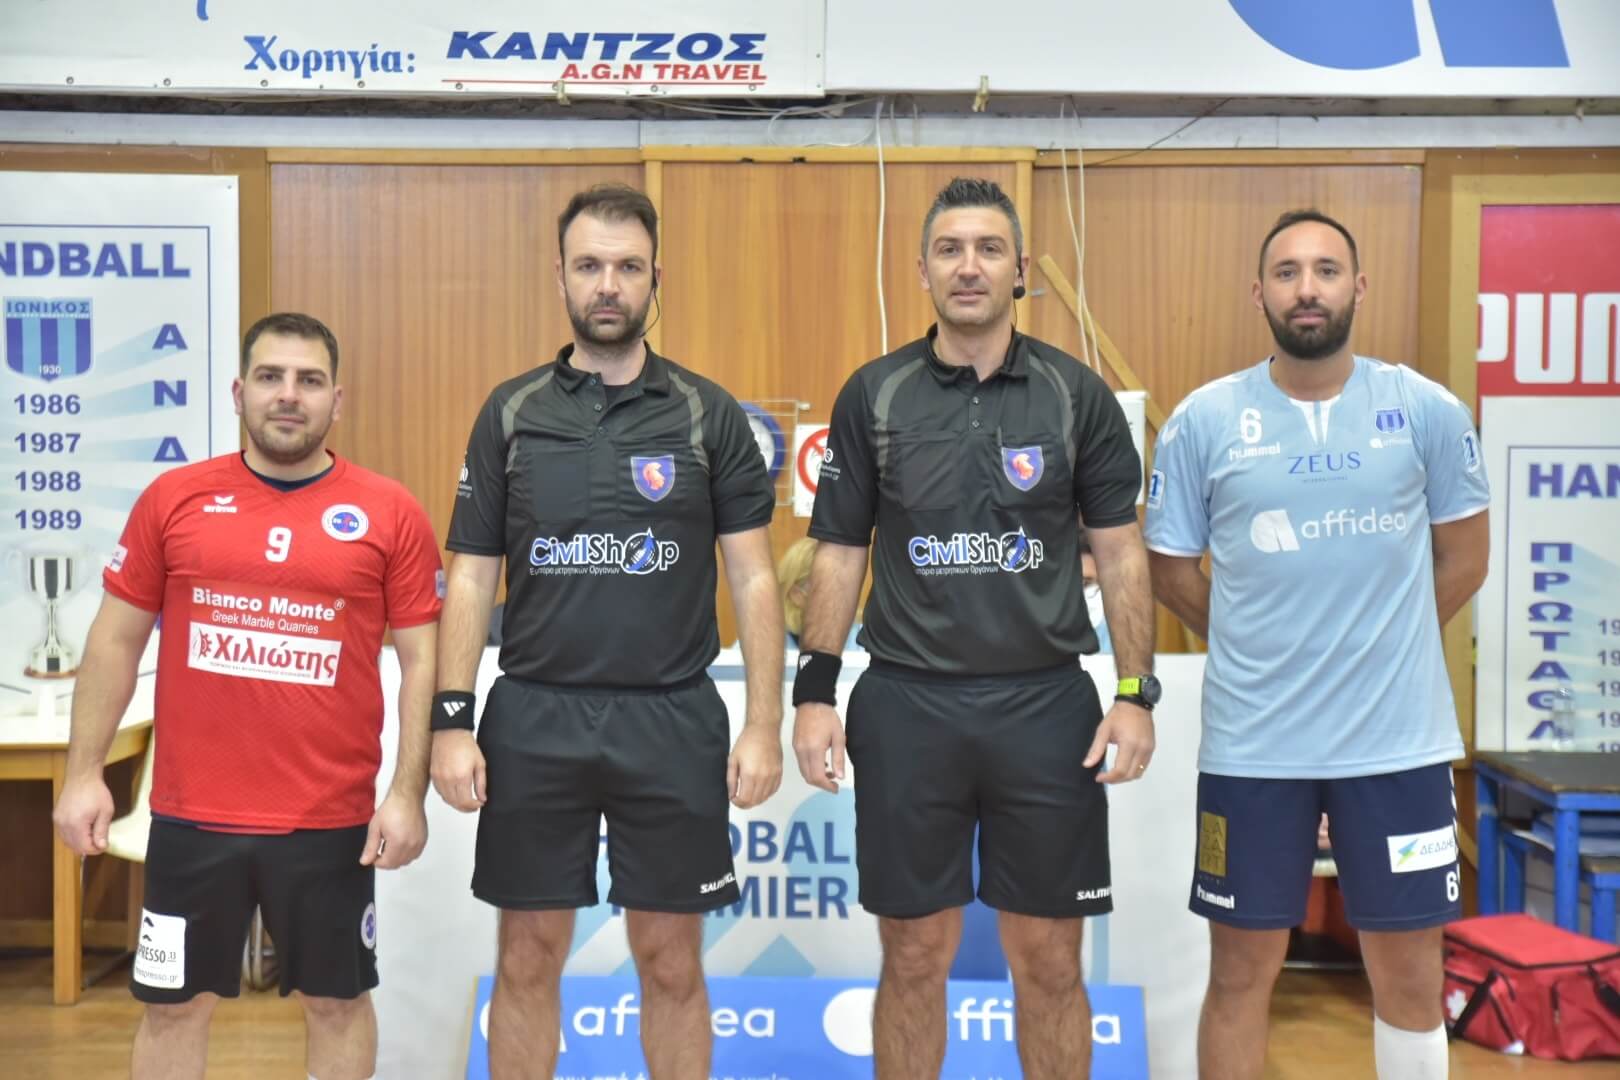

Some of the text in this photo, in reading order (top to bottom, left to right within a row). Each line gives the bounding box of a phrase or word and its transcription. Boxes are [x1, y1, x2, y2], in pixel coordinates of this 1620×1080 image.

[243, 36, 417, 79] Χορηγία:
[447, 31, 767, 61] ΚΑΝΤΖΟΣ
[561, 63, 767, 81] A.G.N TRAVEL
[7, 302, 90, 314] ΙΩΝΙΚΟΣ
[39, 364, 62, 376] 1930
[14, 393, 82, 415] 1986
[1240, 408, 1263, 444] 6
[14, 432, 82, 454] 1987
[1228, 441, 1281, 461] hummel
[1287, 451, 1361, 474] ZEUS
[14, 471, 82, 492] 1988
[14, 509, 82, 531] 1989
[265, 527, 292, 563] 9
[530, 527, 680, 575] CivilShop
[908, 525, 1044, 573] CivilShop
[192, 587, 263, 612] Bianco
[212, 610, 319, 635] Greek Marble Quarries
[213, 632, 337, 680] Χιλιώτης
[1197, 883, 1235, 910] hummel
[1446, 871, 1459, 902] 6
[573, 993, 776, 1038] afea
